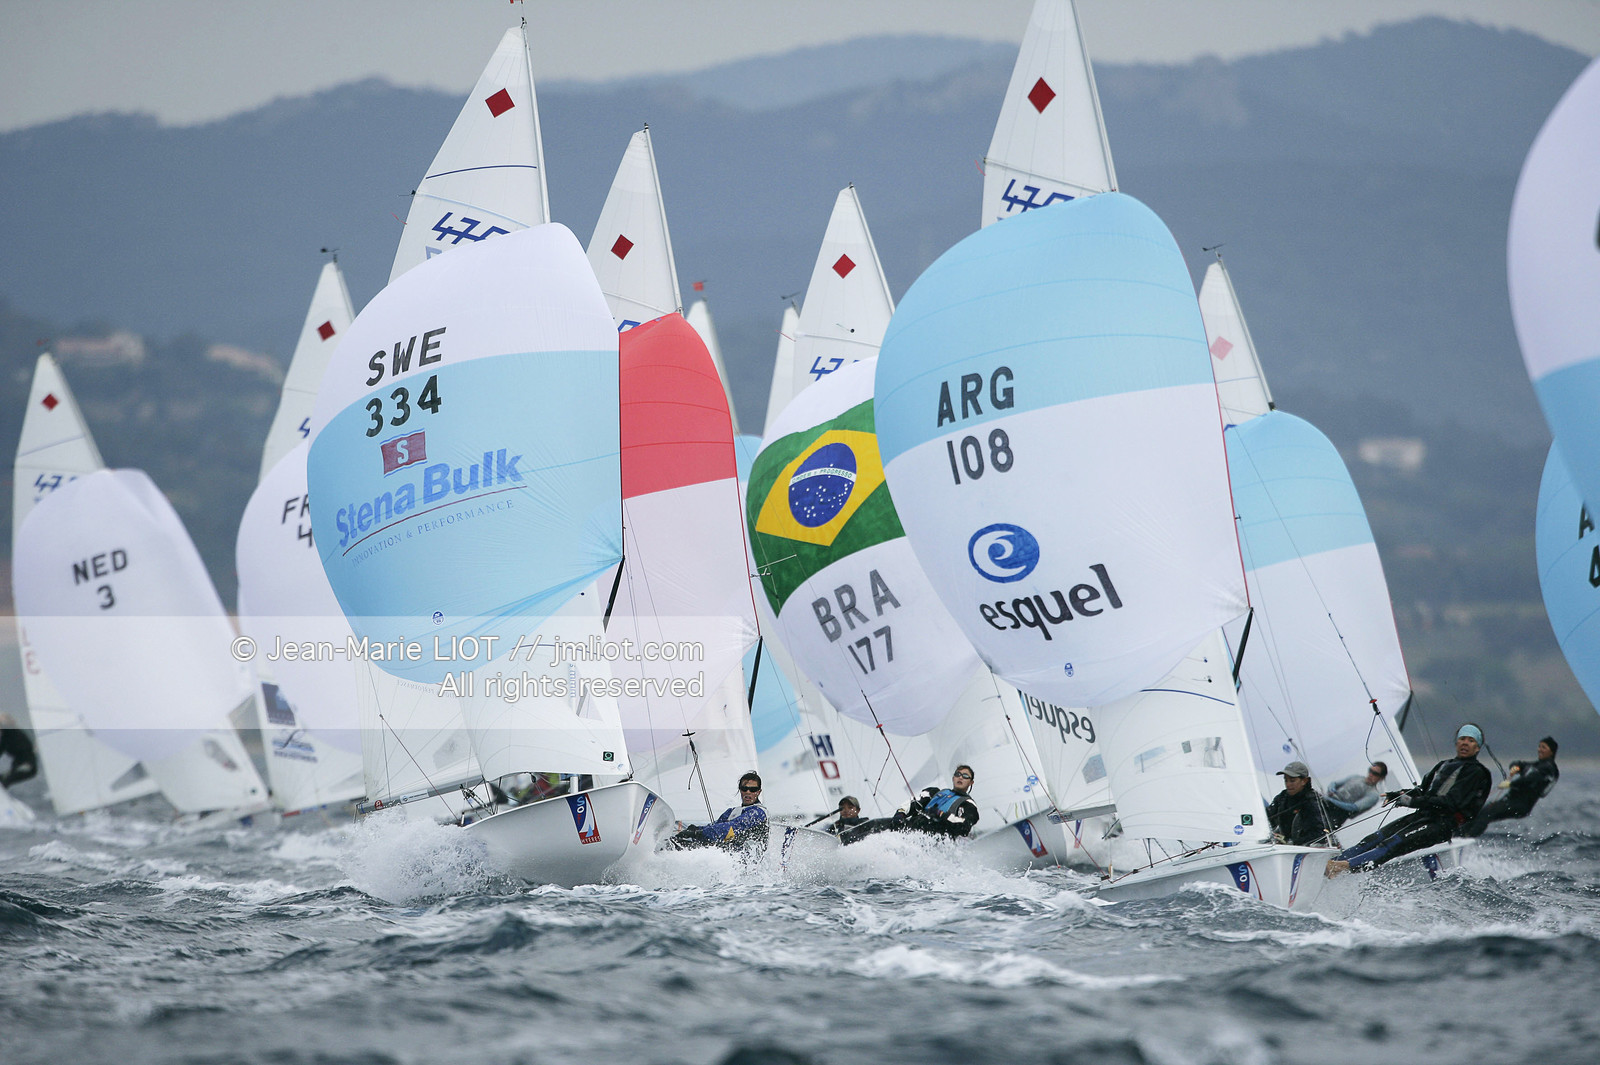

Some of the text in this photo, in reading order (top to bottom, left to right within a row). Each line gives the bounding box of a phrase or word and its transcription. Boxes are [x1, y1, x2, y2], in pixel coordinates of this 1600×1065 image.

[365, 326, 447, 387] SWE
[365, 374, 442, 438] 334
[937, 365, 1015, 428] ARG
[946, 428, 1015, 486] 108
[335, 447, 525, 548] Stena Bulk
[351, 499, 514, 569] INNOVATION & PERFORMANCE
[72, 549, 129, 585] NED
[96, 584, 116, 610] 3
[811, 568, 902, 643] BRA
[978, 563, 1123, 641] esquel
[847, 625, 894, 675] 177
